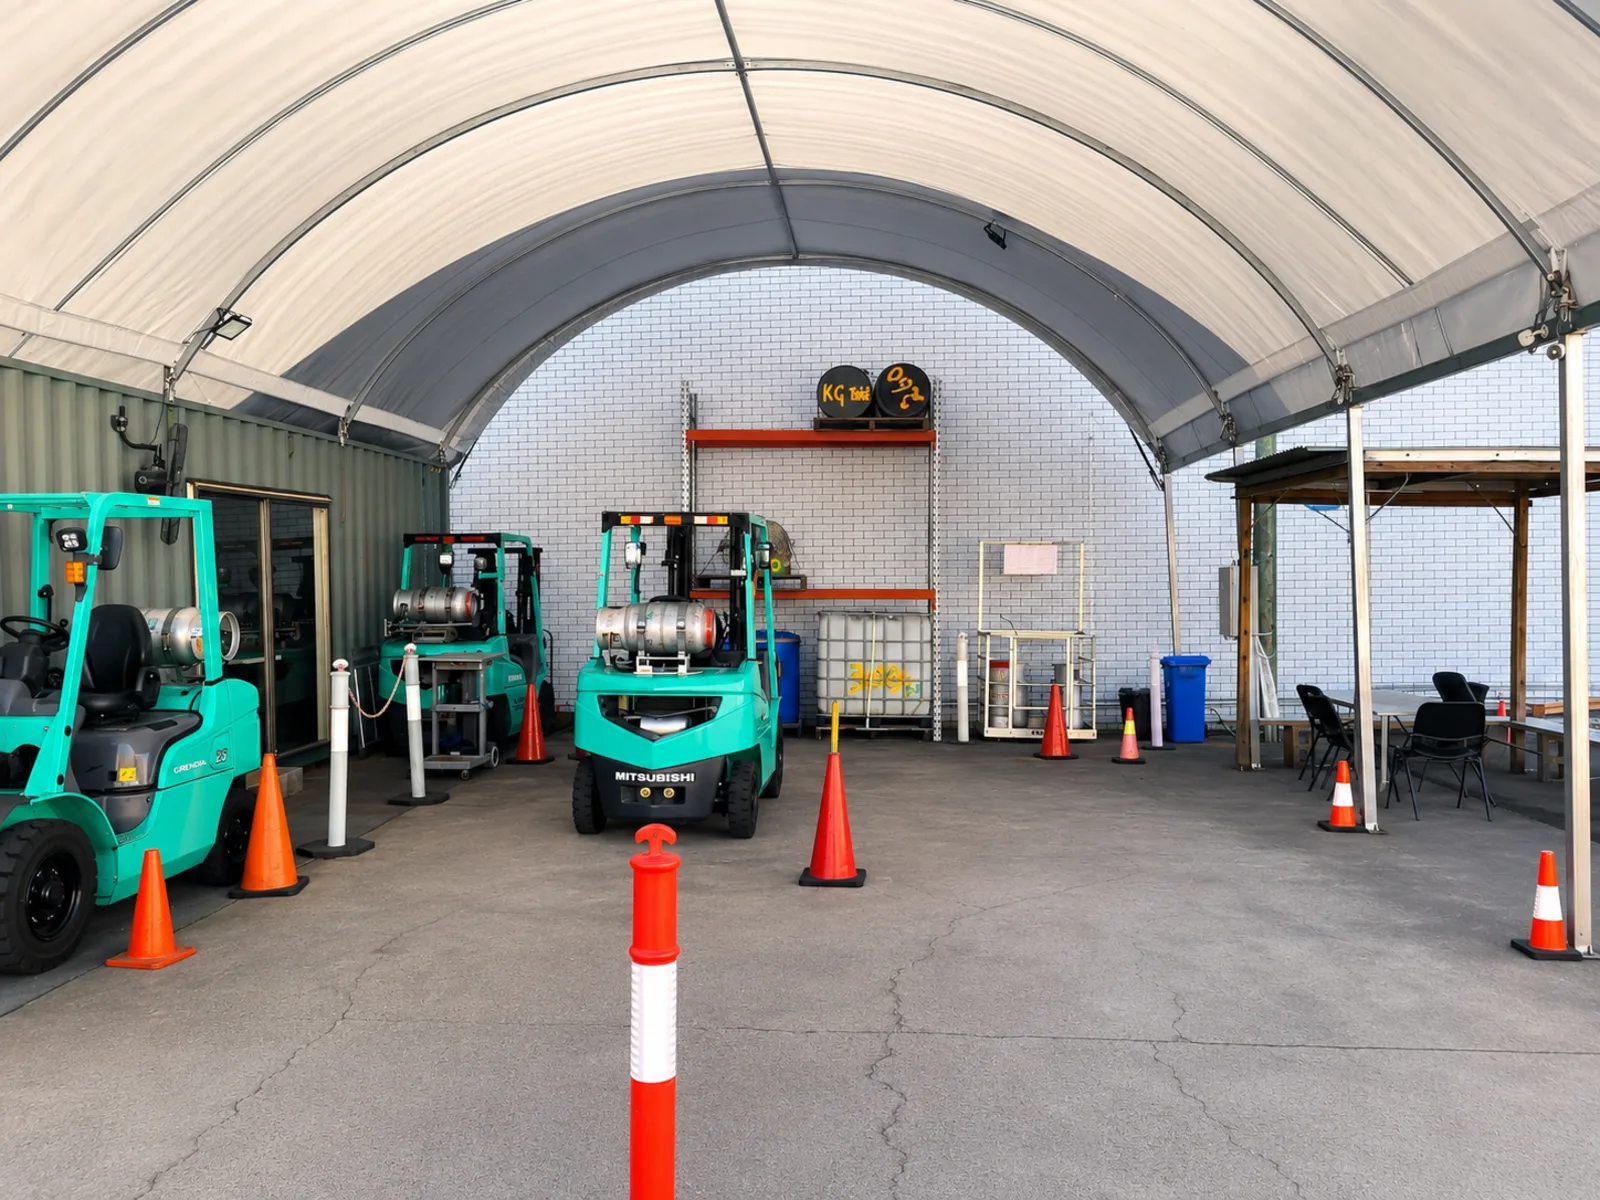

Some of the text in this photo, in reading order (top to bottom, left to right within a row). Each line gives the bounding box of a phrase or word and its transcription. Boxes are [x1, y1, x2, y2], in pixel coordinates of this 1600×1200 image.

[822, 383, 845, 407] KG
[173, 759, 207, 775] GRENDIA
[614, 771, 695, 783] MITSUBISHI
